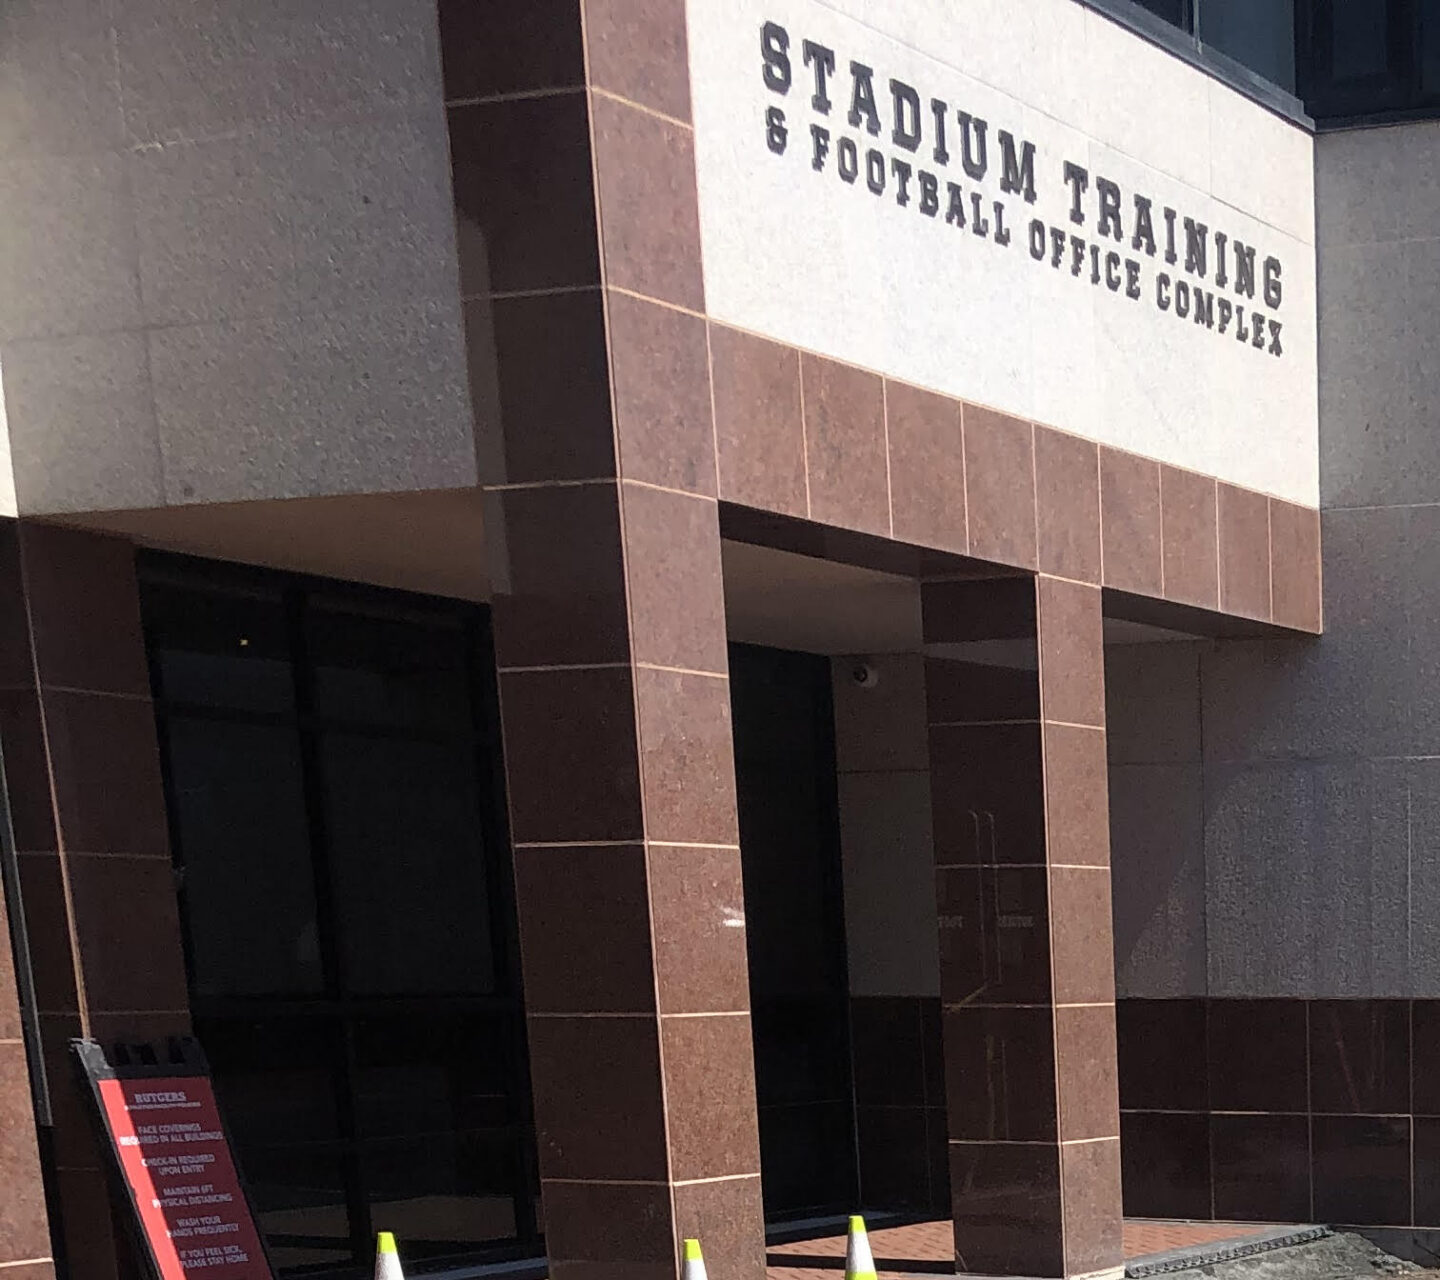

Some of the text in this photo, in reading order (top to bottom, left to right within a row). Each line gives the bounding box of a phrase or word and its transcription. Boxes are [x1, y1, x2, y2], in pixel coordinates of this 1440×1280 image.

[760, 21, 1282, 310] STADIUM TRAINING
[765, 105, 1283, 358] & FOOTBALL OFFICE COMPLEX
[135, 1092, 186, 1102] RUTGERS
[138, 1123, 201, 1134] FACE COVERINGS
[171, 1134, 183, 1142] ALL
[185, 1132, 223, 1141] BUILDINGS
[179, 1155, 215, 1164] REQUIRED
[159, 1165, 204, 1175] UPON ENTRY
[164, 1186, 199, 1195] MAINTAIN
[189, 1194, 232, 1204] DISTANCING
[177, 1216, 221, 1227] WASH YOUR
[195, 1223, 238, 1235] FREQUENTLY
[188, 1249, 204, 1257] YOU
[206, 1247, 222, 1256] FEEL
[208, 1257, 224, 1266] STAY
[226, 1253, 248, 1264] HOME
